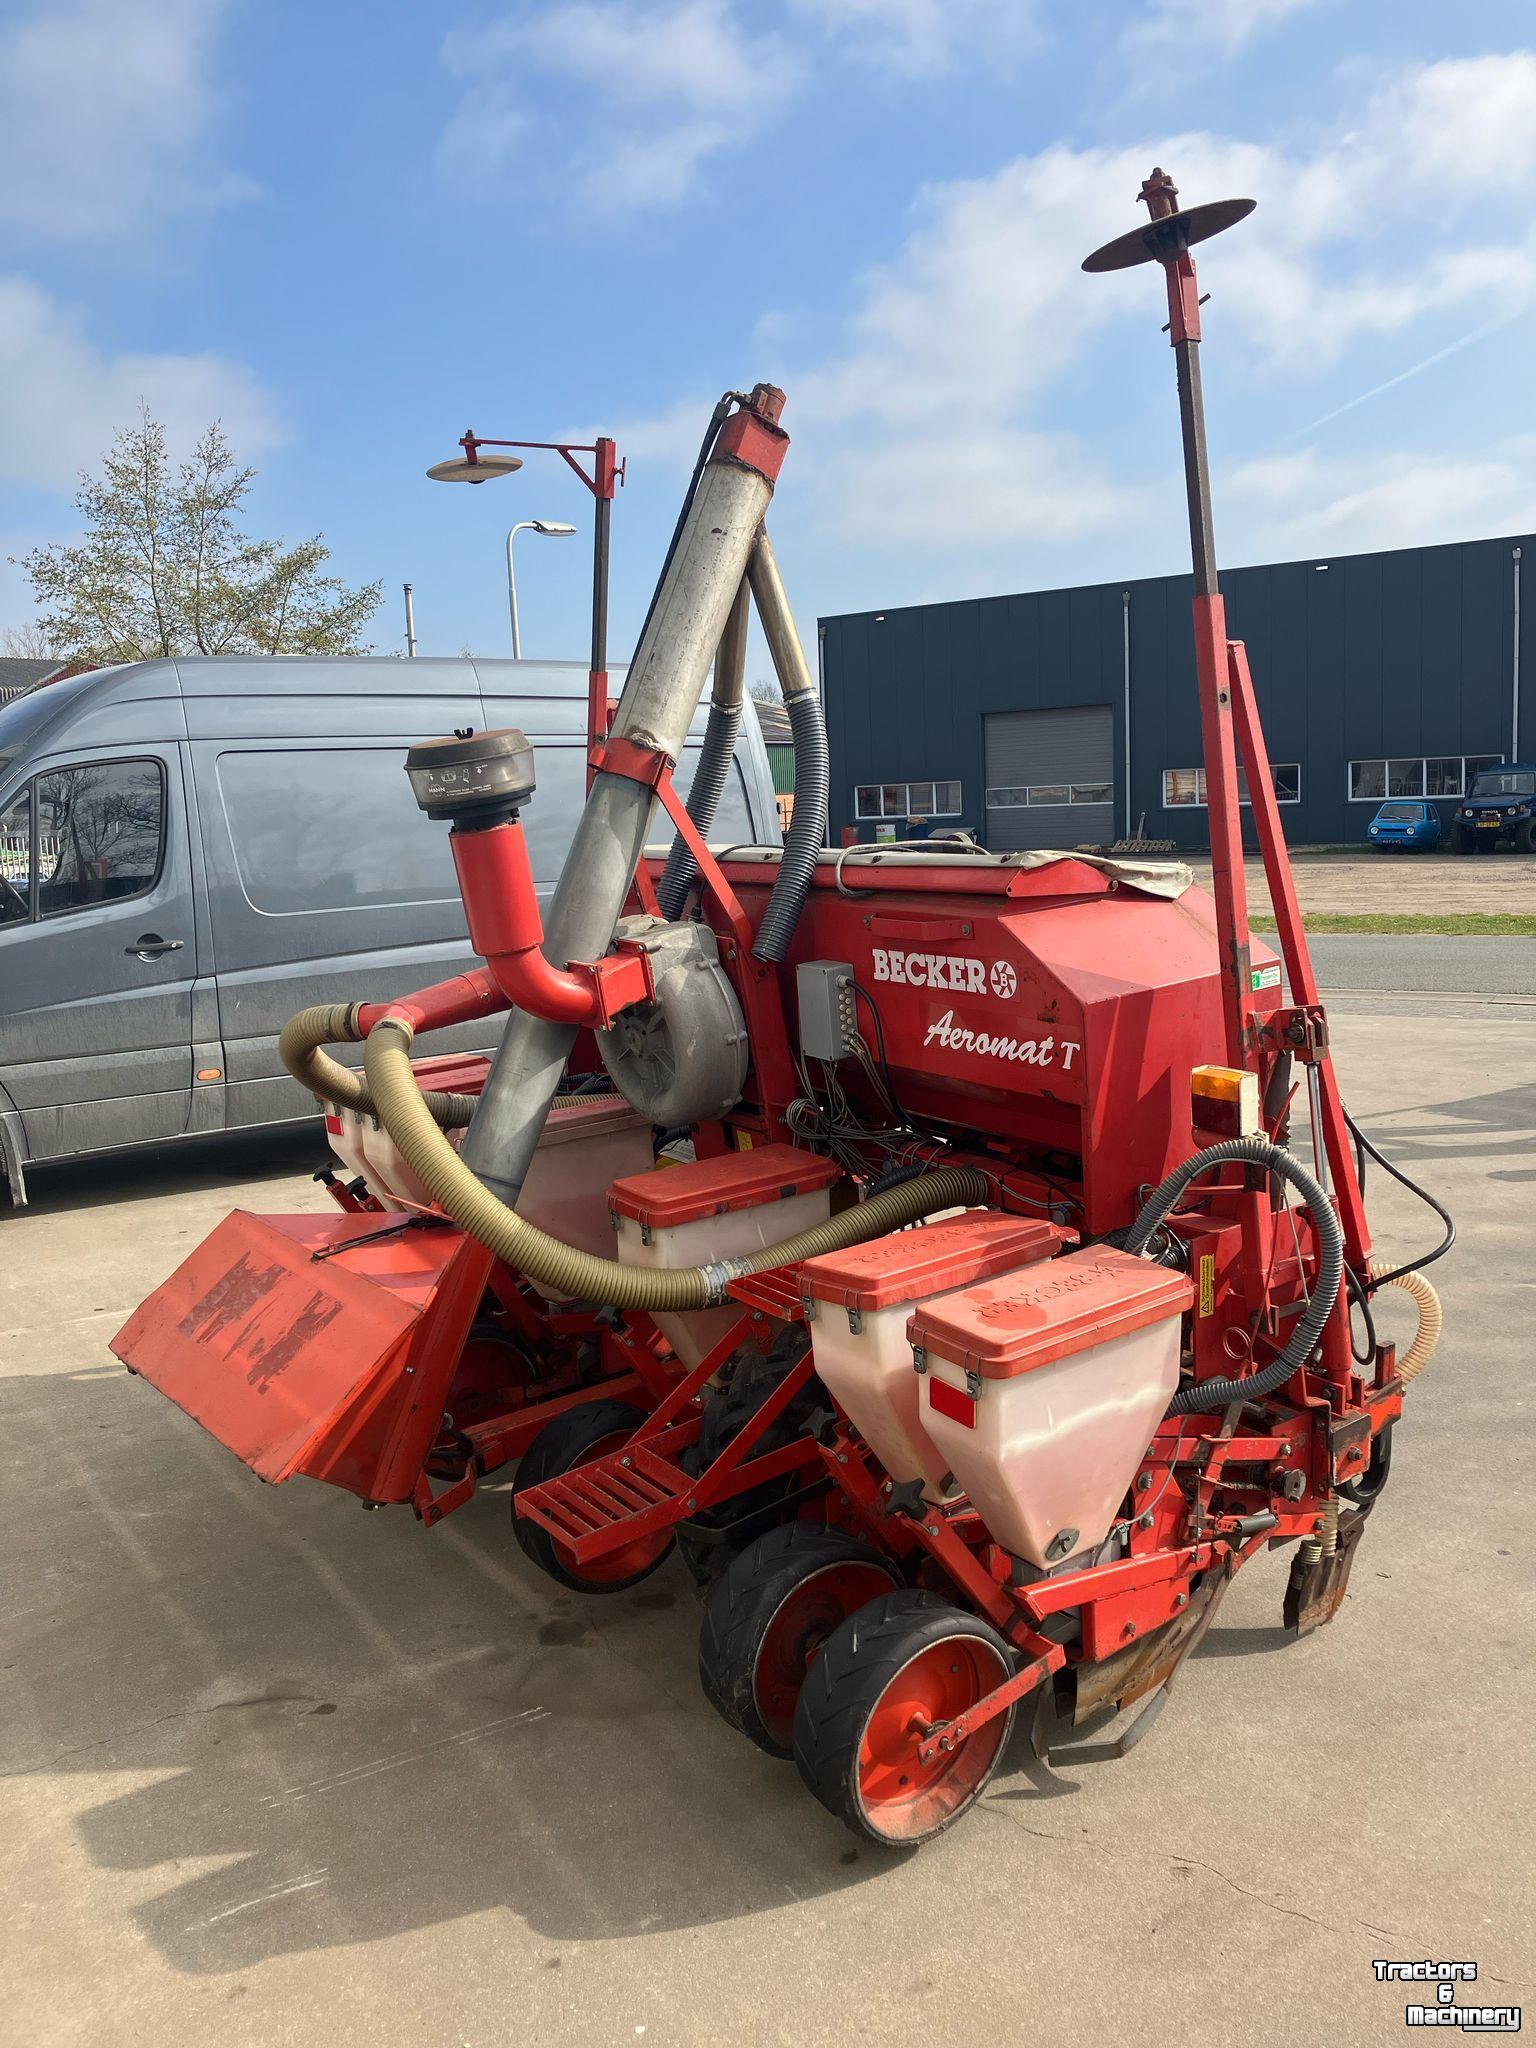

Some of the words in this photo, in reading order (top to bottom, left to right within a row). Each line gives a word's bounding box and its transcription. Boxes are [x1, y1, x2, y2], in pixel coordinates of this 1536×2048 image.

[872, 948, 988, 995] BECKER
[923, 1009, 1054, 1067] Aeromat
[1060, 1041, 1081, 1070] T
